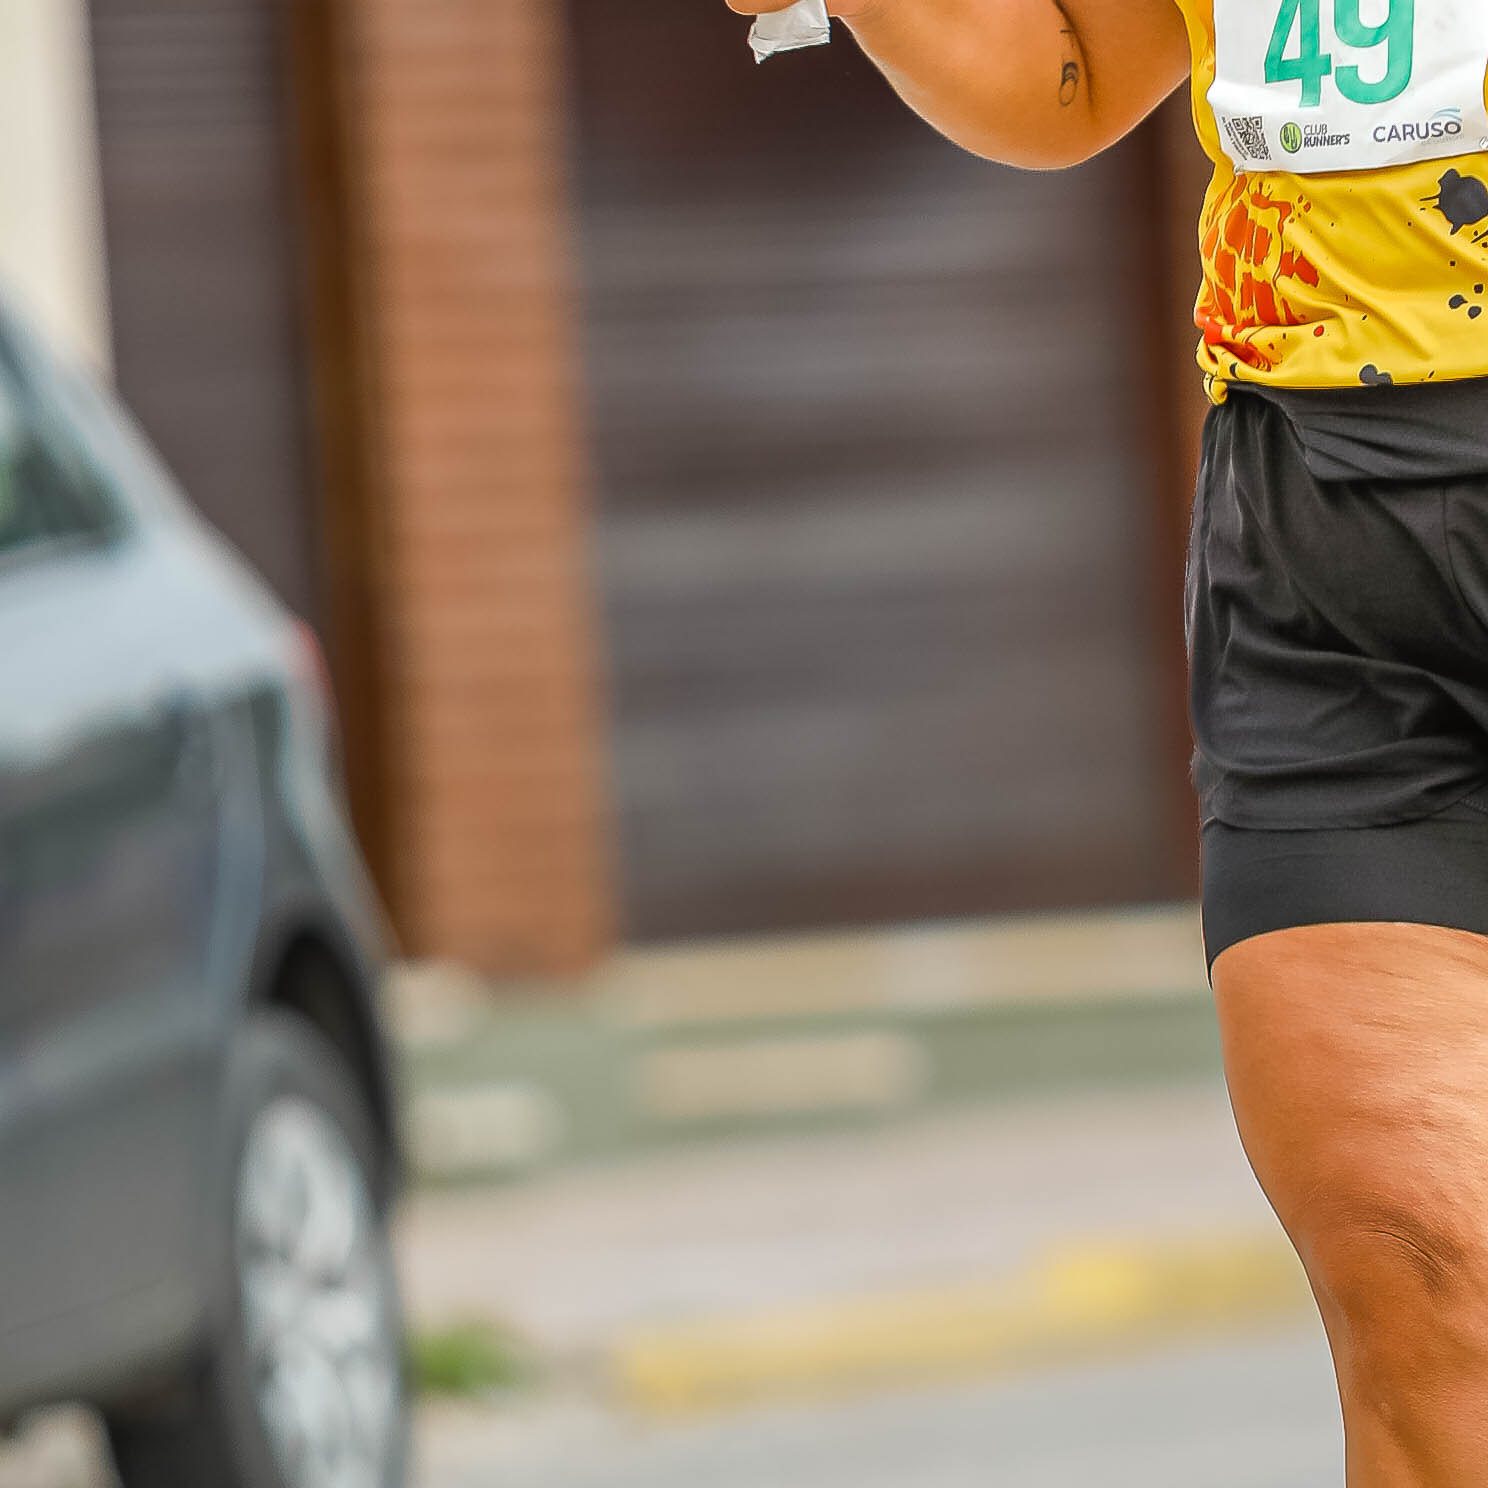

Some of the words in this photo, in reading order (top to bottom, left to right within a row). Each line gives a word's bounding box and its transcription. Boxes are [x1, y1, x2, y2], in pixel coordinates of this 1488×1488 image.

[1303, 123, 1328, 136] CLUB
[1372, 121, 1462, 143] CARUSO
[1303, 133, 1350, 148] RUNNER'S
